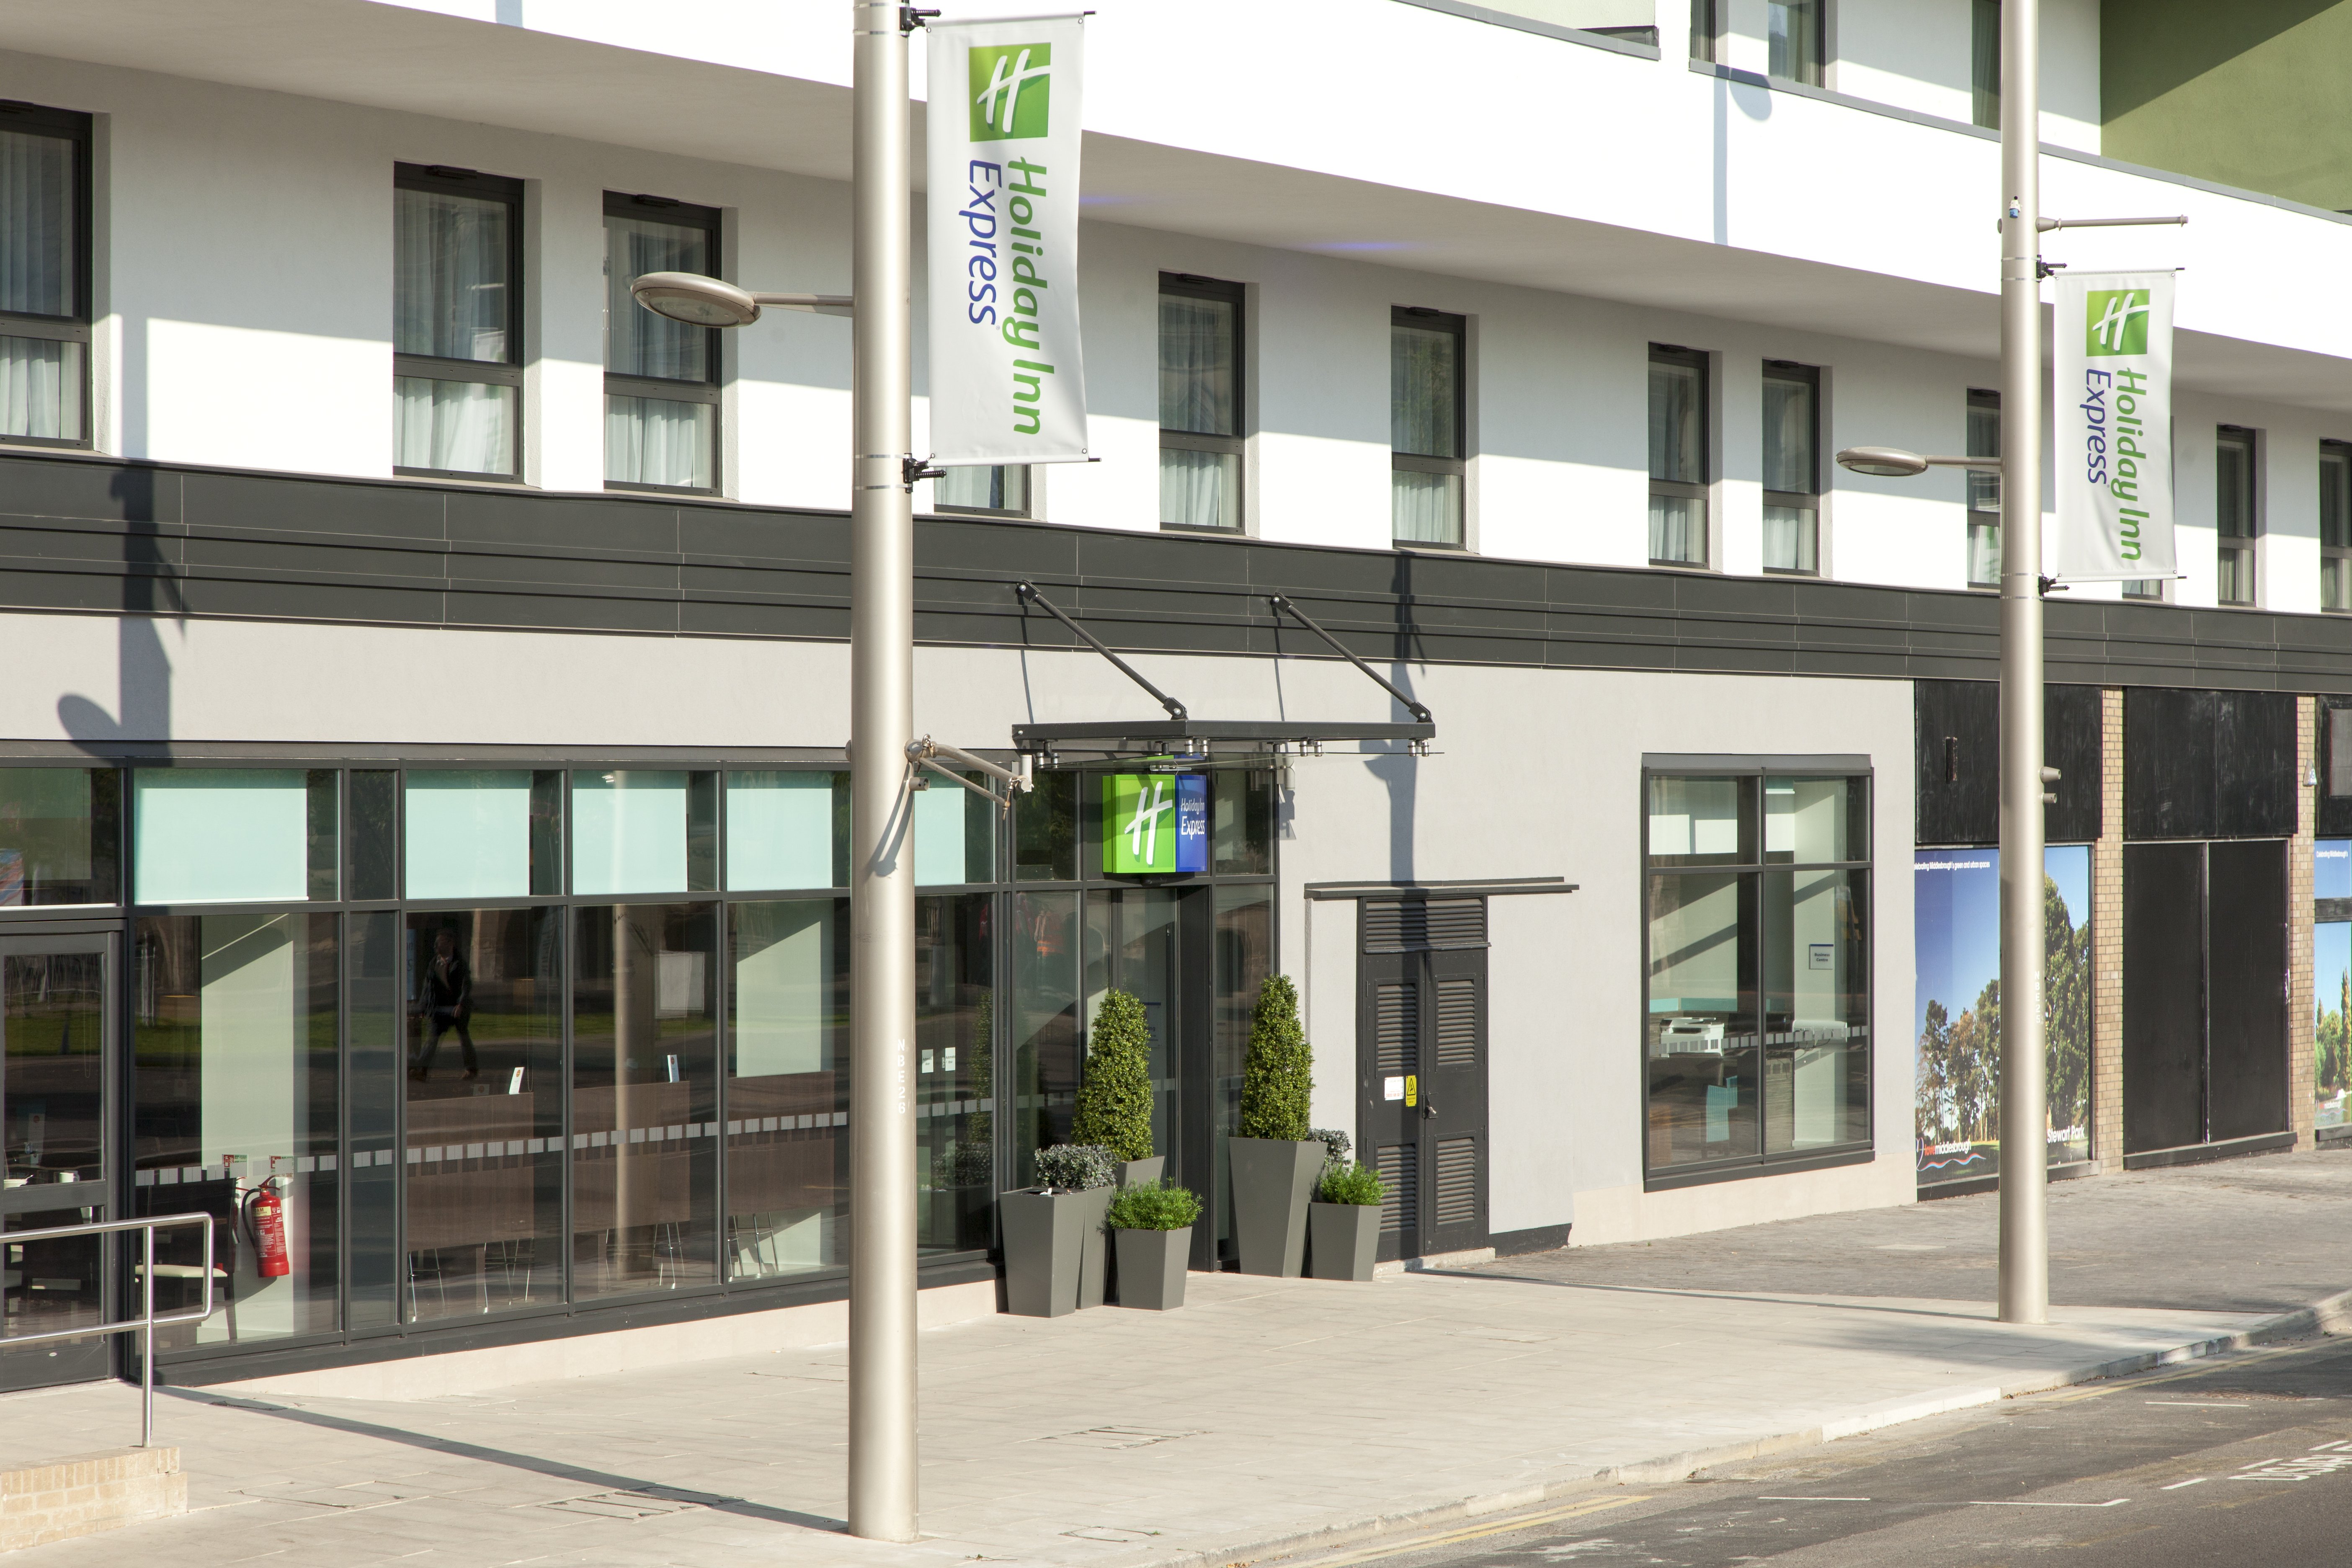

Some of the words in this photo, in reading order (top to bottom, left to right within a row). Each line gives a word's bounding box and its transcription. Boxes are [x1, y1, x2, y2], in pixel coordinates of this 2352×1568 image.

[959, 160, 1001, 325] Express
[1002, 157, 1047, 351] Holiday
[1013, 360, 1055, 436] Inn
[2080, 369, 2111, 484] Express
[2110, 367, 2147, 502] Holiday
[2118, 508, 2149, 560] Inn
[1181, 798, 1199, 815] Holiday
[1181, 815, 1205, 840] Express
[1914, 862, 1929, 871] elebrating
[1930, 861, 1954, 870] Middlesbrough's
[2047, 1125, 2070, 1143] Stewart
[2071, 1124, 2085, 1140] Park
